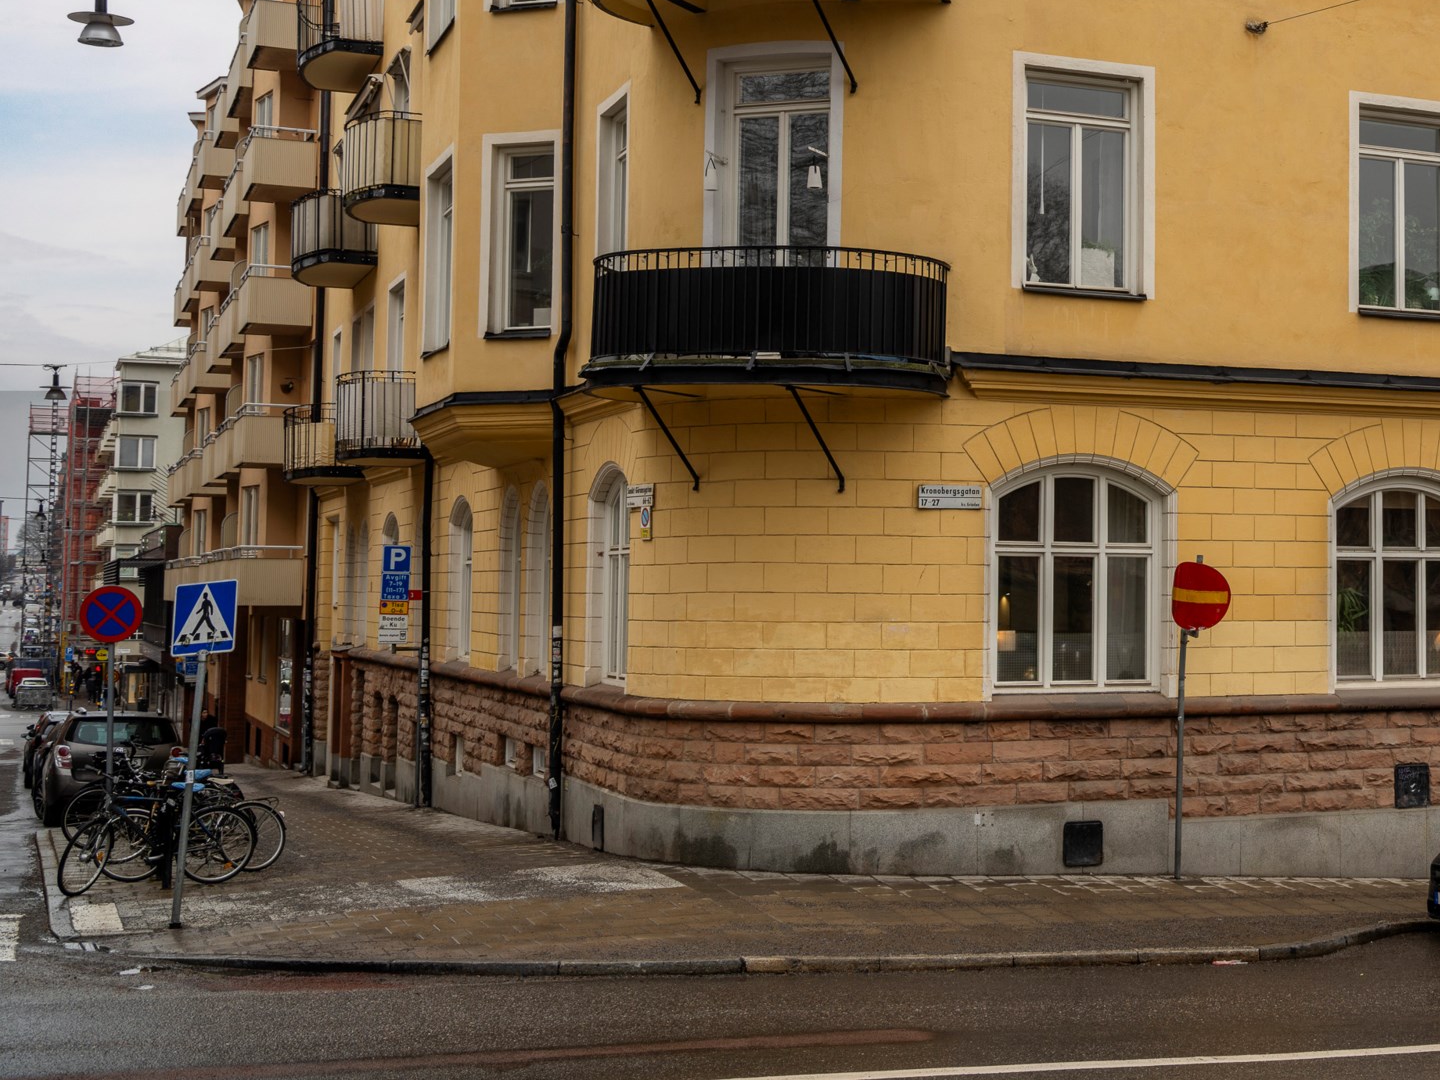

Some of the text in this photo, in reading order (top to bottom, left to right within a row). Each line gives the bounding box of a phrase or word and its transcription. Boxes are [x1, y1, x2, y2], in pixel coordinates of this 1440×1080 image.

[920, 486, 980, 497] Kronobergsgatan
[390, 548, 407, 570] P
[385, 574, 407, 582] Avgift
